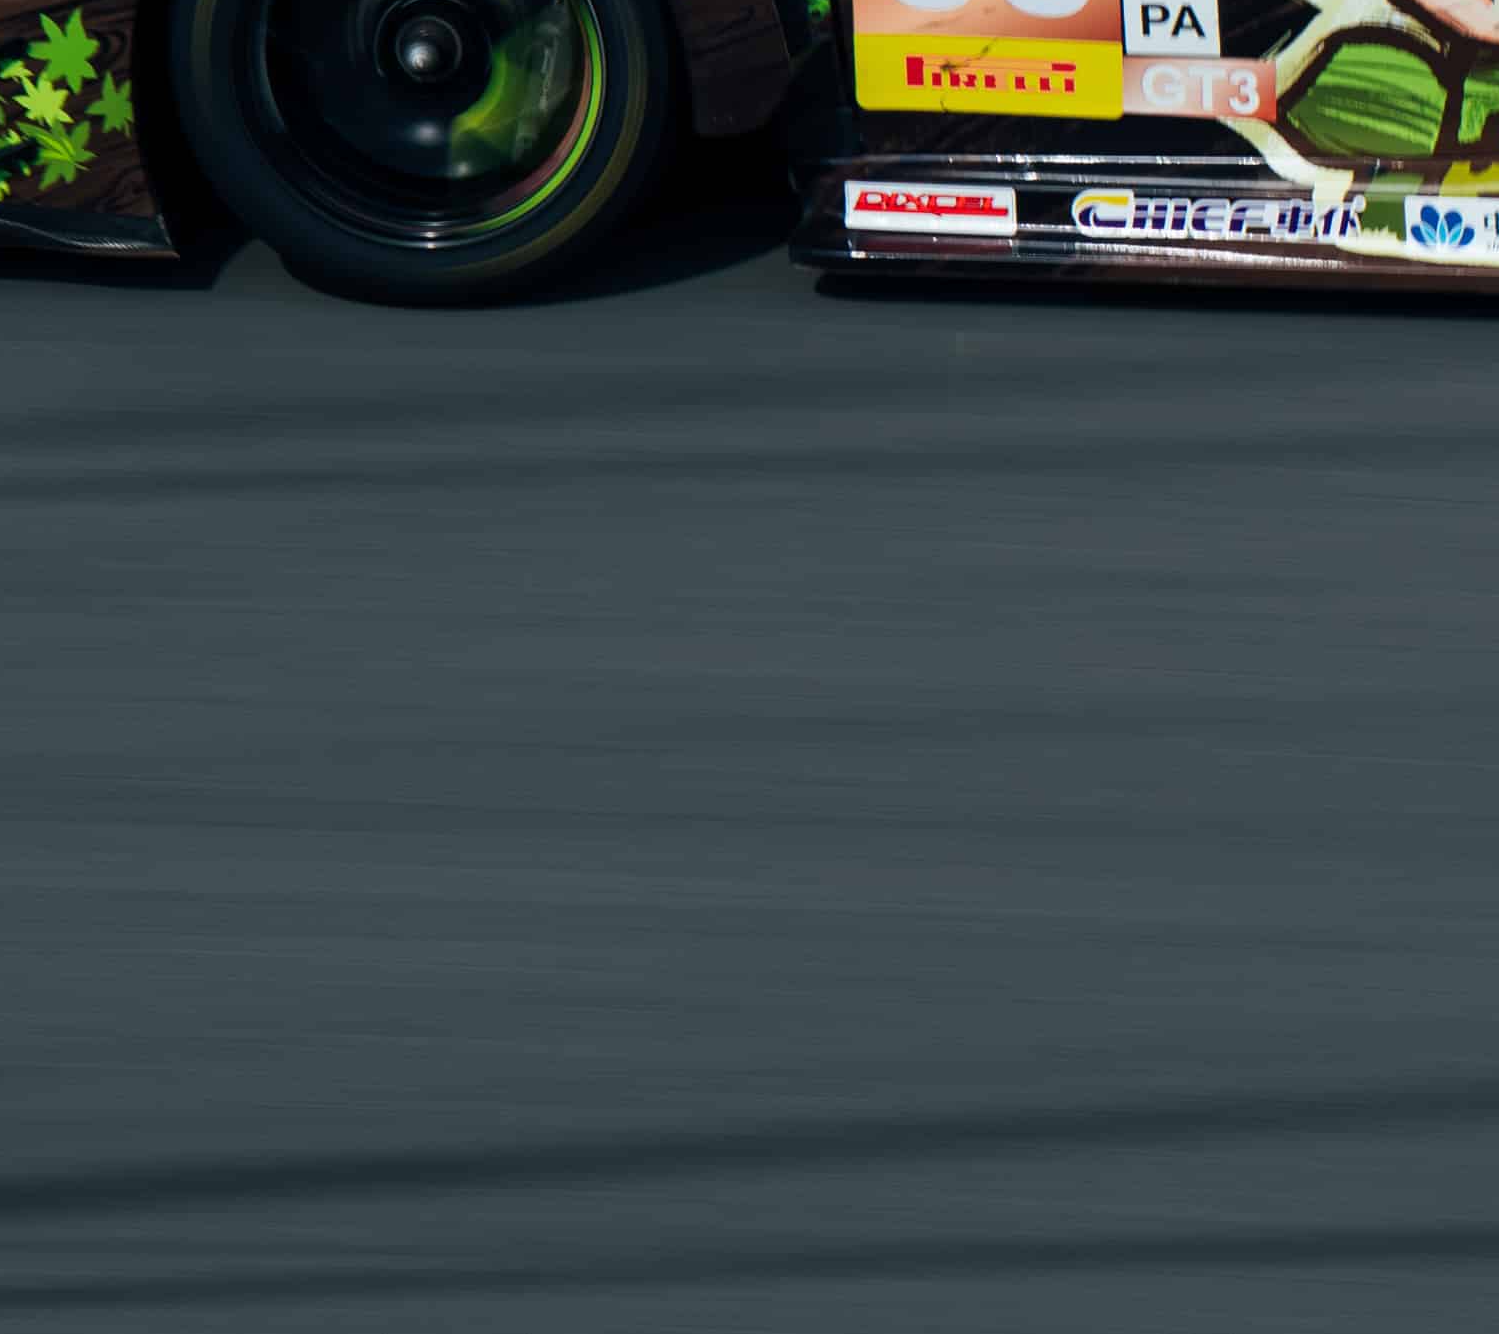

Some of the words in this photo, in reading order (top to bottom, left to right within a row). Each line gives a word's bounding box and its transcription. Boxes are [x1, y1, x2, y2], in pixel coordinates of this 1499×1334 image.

[1140, 3, 1206, 39] PA
[905, 54, 1077, 94] PIRELLI
[1141, 63, 1262, 116] GT3
